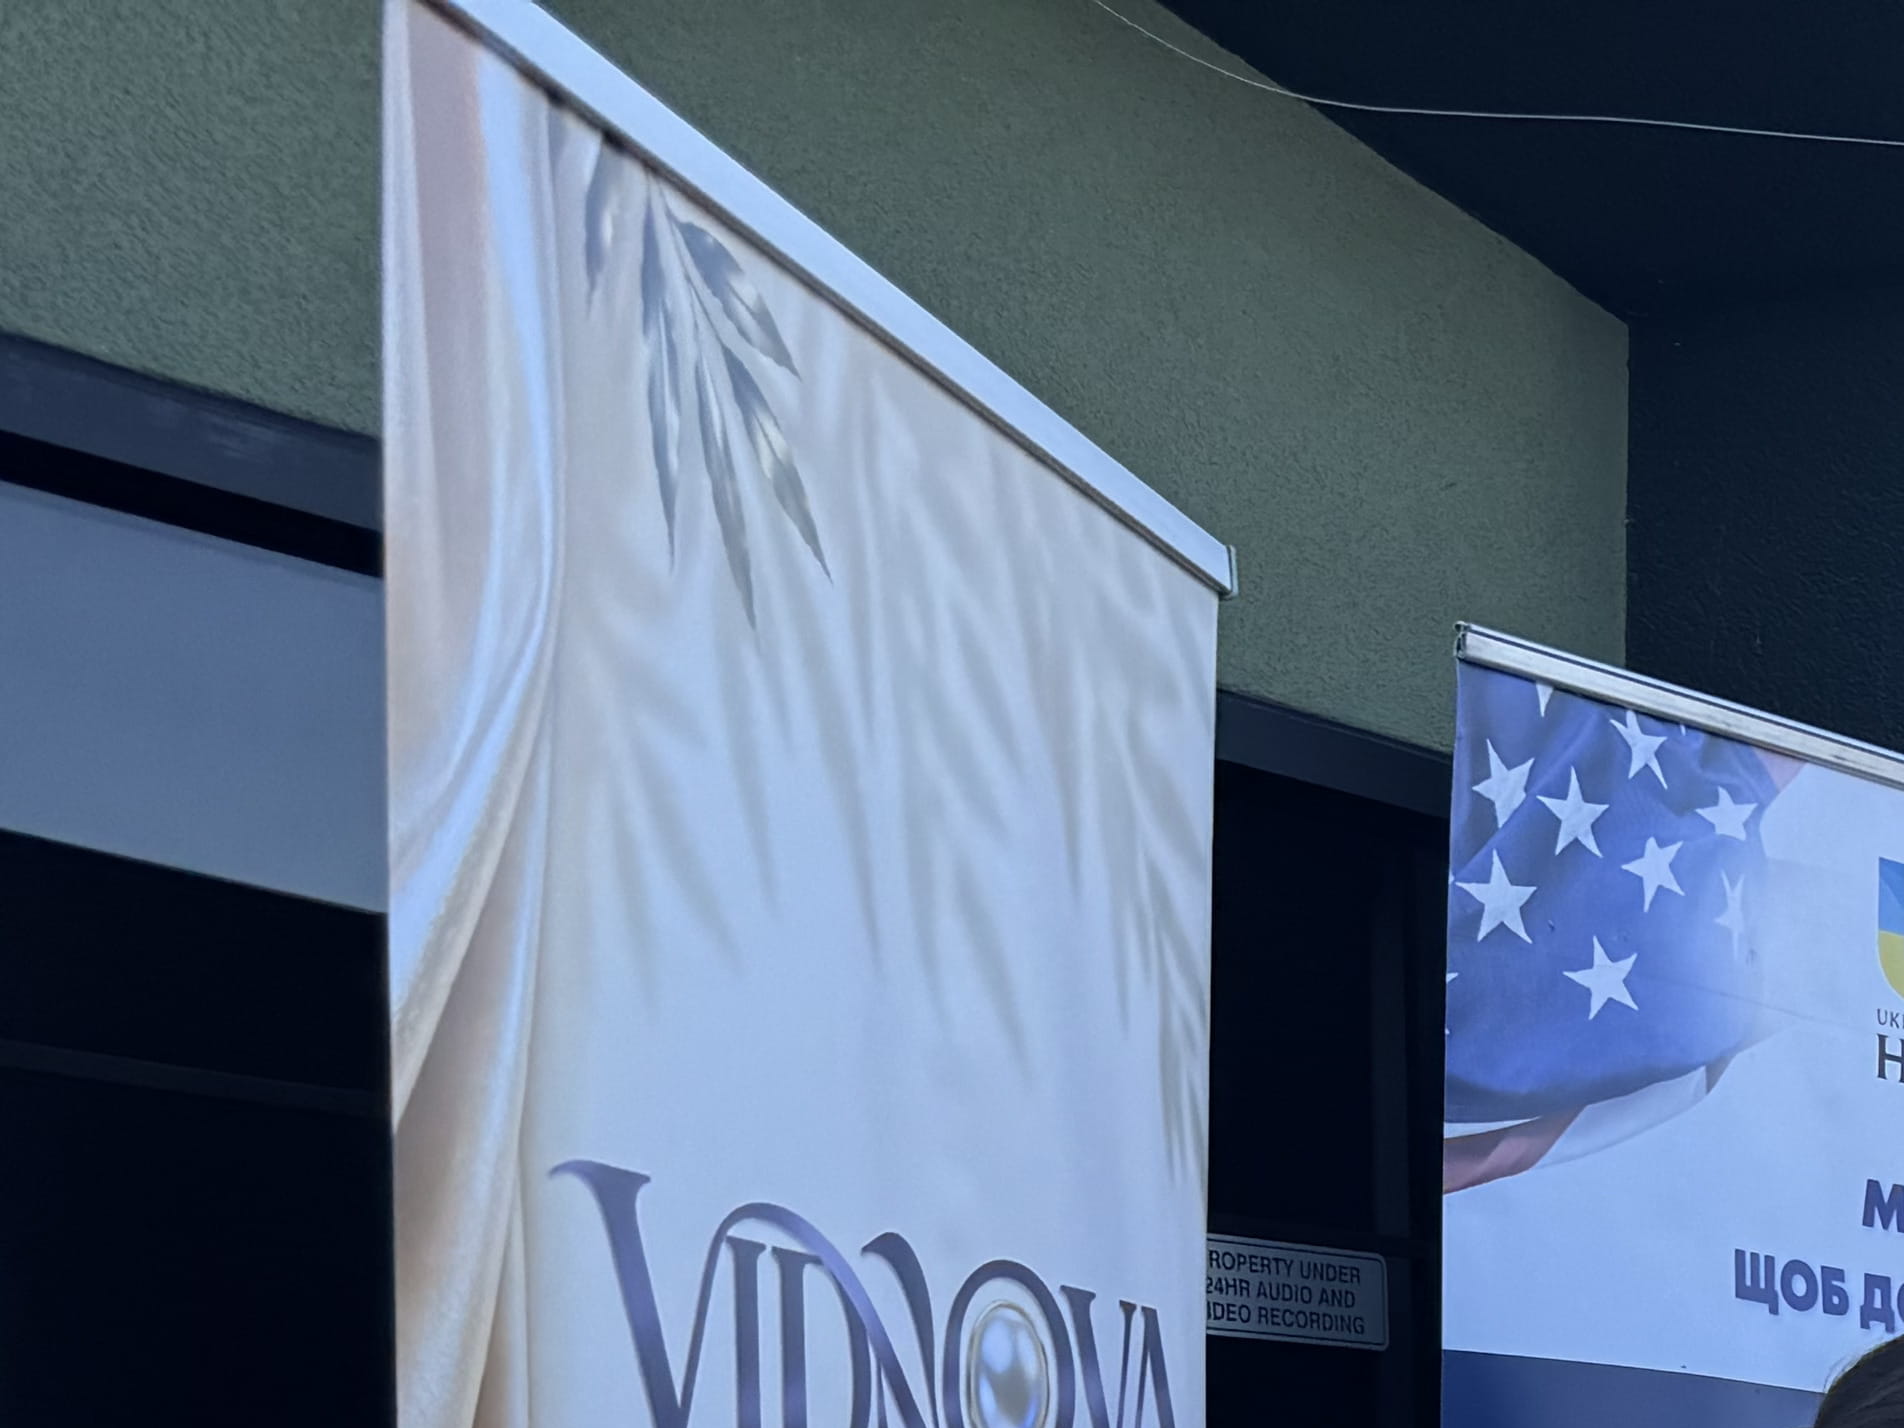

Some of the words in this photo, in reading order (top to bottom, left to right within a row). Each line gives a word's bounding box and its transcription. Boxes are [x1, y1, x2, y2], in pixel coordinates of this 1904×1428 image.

[1208, 1249, 1294, 1278] ROPERTY
[1300, 1261, 1361, 1285] UNDER
[1734, 1247, 1850, 1318] ЩОБ
[1256, 1281, 1313, 1305] AUDIO
[1318, 1287, 1356, 1309] AND
[1257, 1305, 1366, 1336] RECORDING
